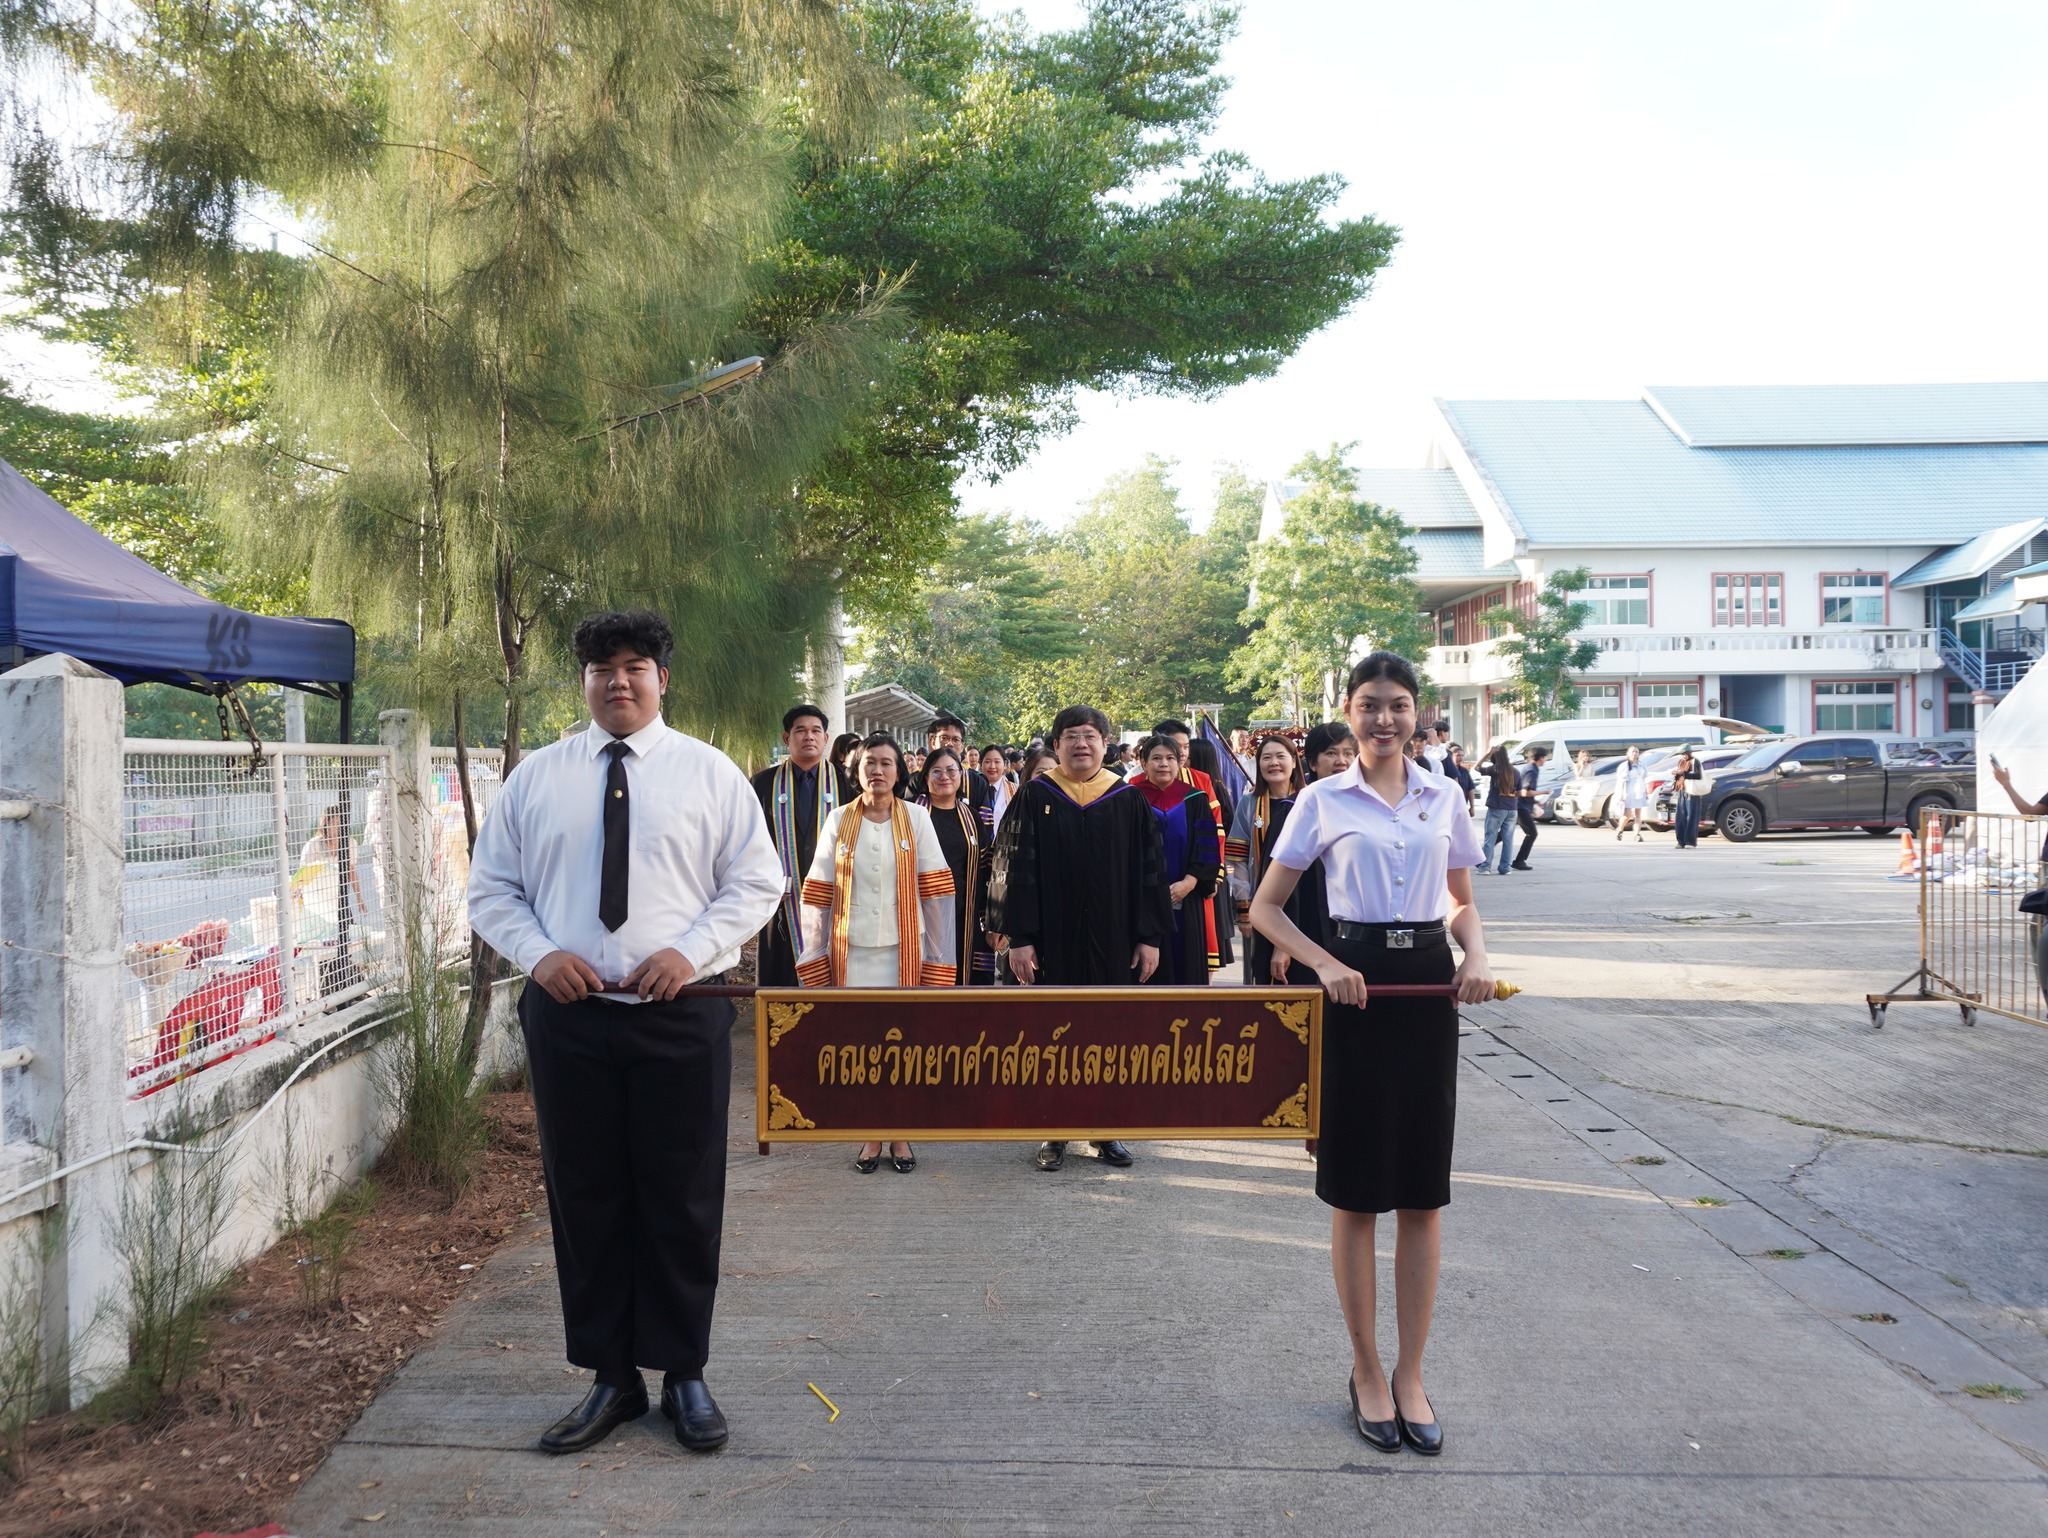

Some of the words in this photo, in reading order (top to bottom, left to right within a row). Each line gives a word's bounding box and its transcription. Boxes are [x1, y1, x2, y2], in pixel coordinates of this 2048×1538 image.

[817, 1017, 1259, 1086] คณะวิทยาศาสตร์และเทคโนโลยี
